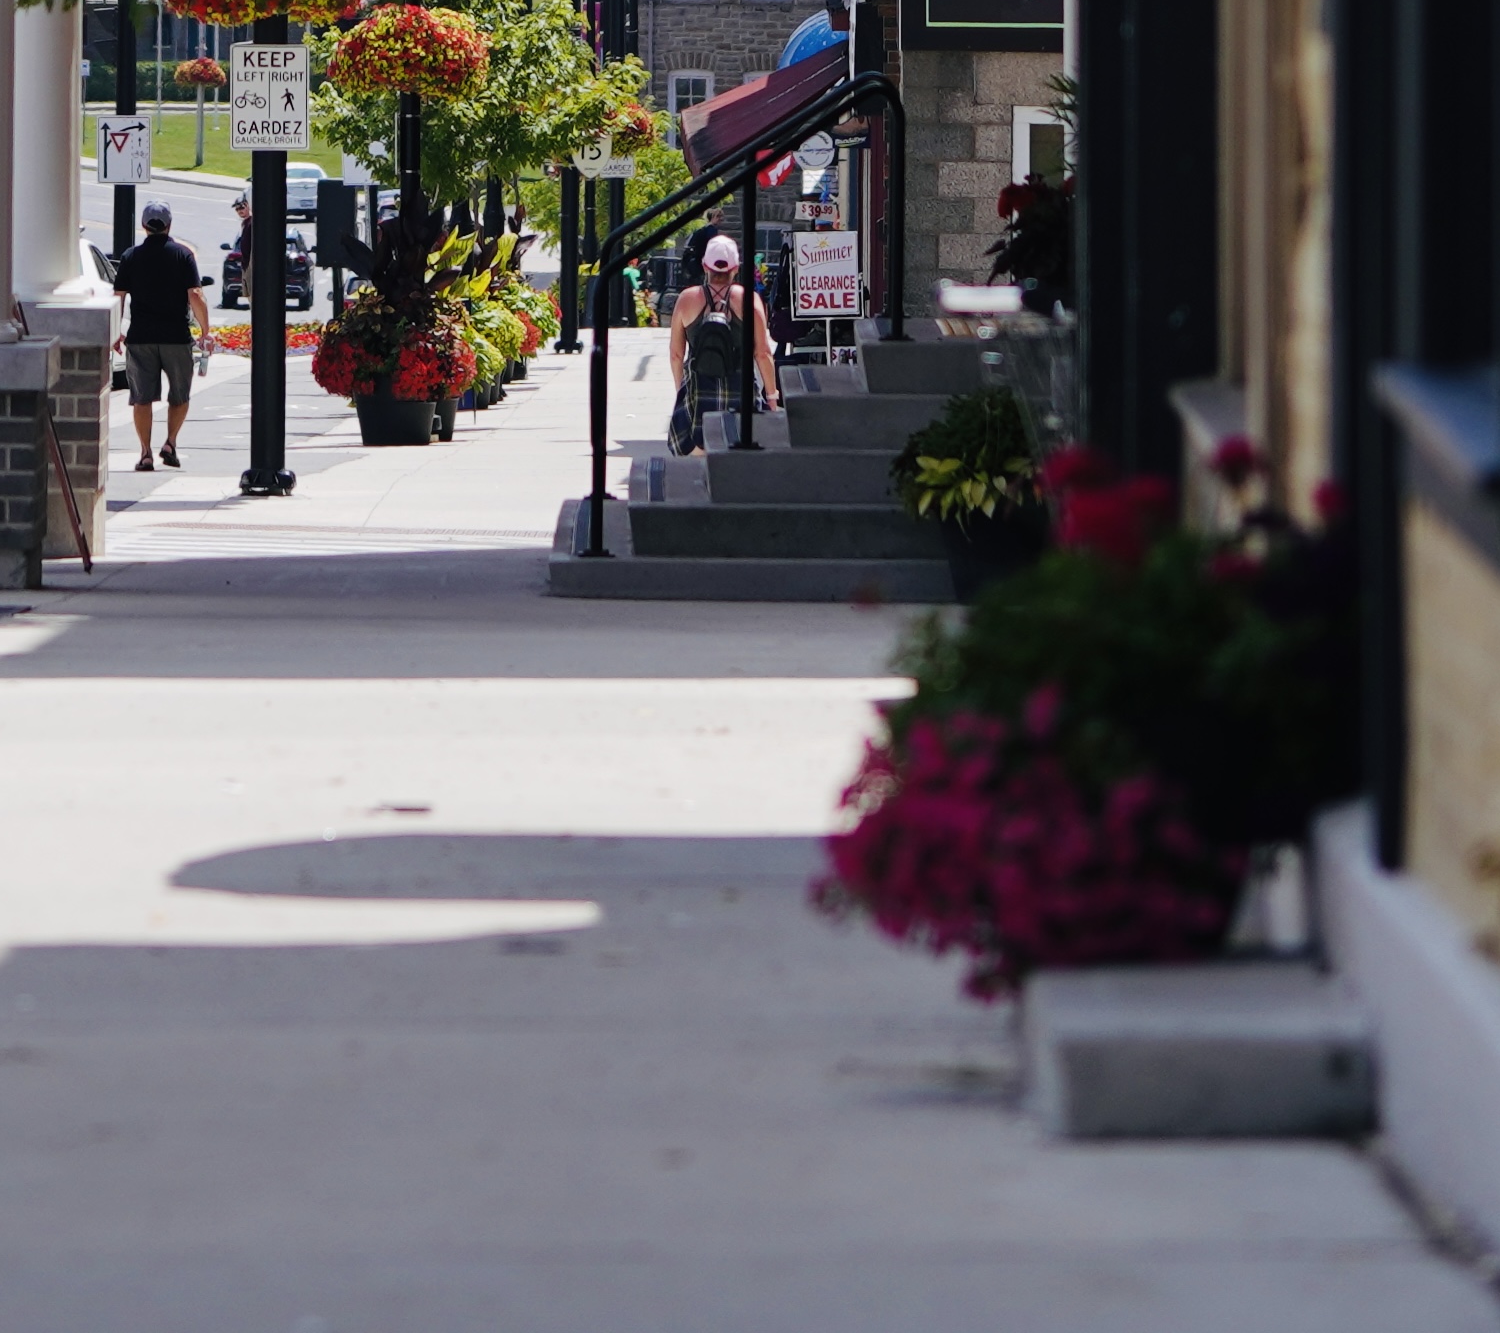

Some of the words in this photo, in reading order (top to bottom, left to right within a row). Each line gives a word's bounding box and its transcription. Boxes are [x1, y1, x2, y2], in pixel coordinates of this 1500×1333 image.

[244, 51, 295, 67] KEEP
[236, 71, 265, 82] LEFT
[271, 71, 304, 82] RIGHT
[237, 120, 302, 135] GARDEZ
[235, 136, 268, 144] GAUCHE
[274, 136, 302, 144] DROITE
[798, 244, 853, 266] Summer
[799, 275, 856, 291] CLEARANCE
[799, 292, 856, 310] SALE
